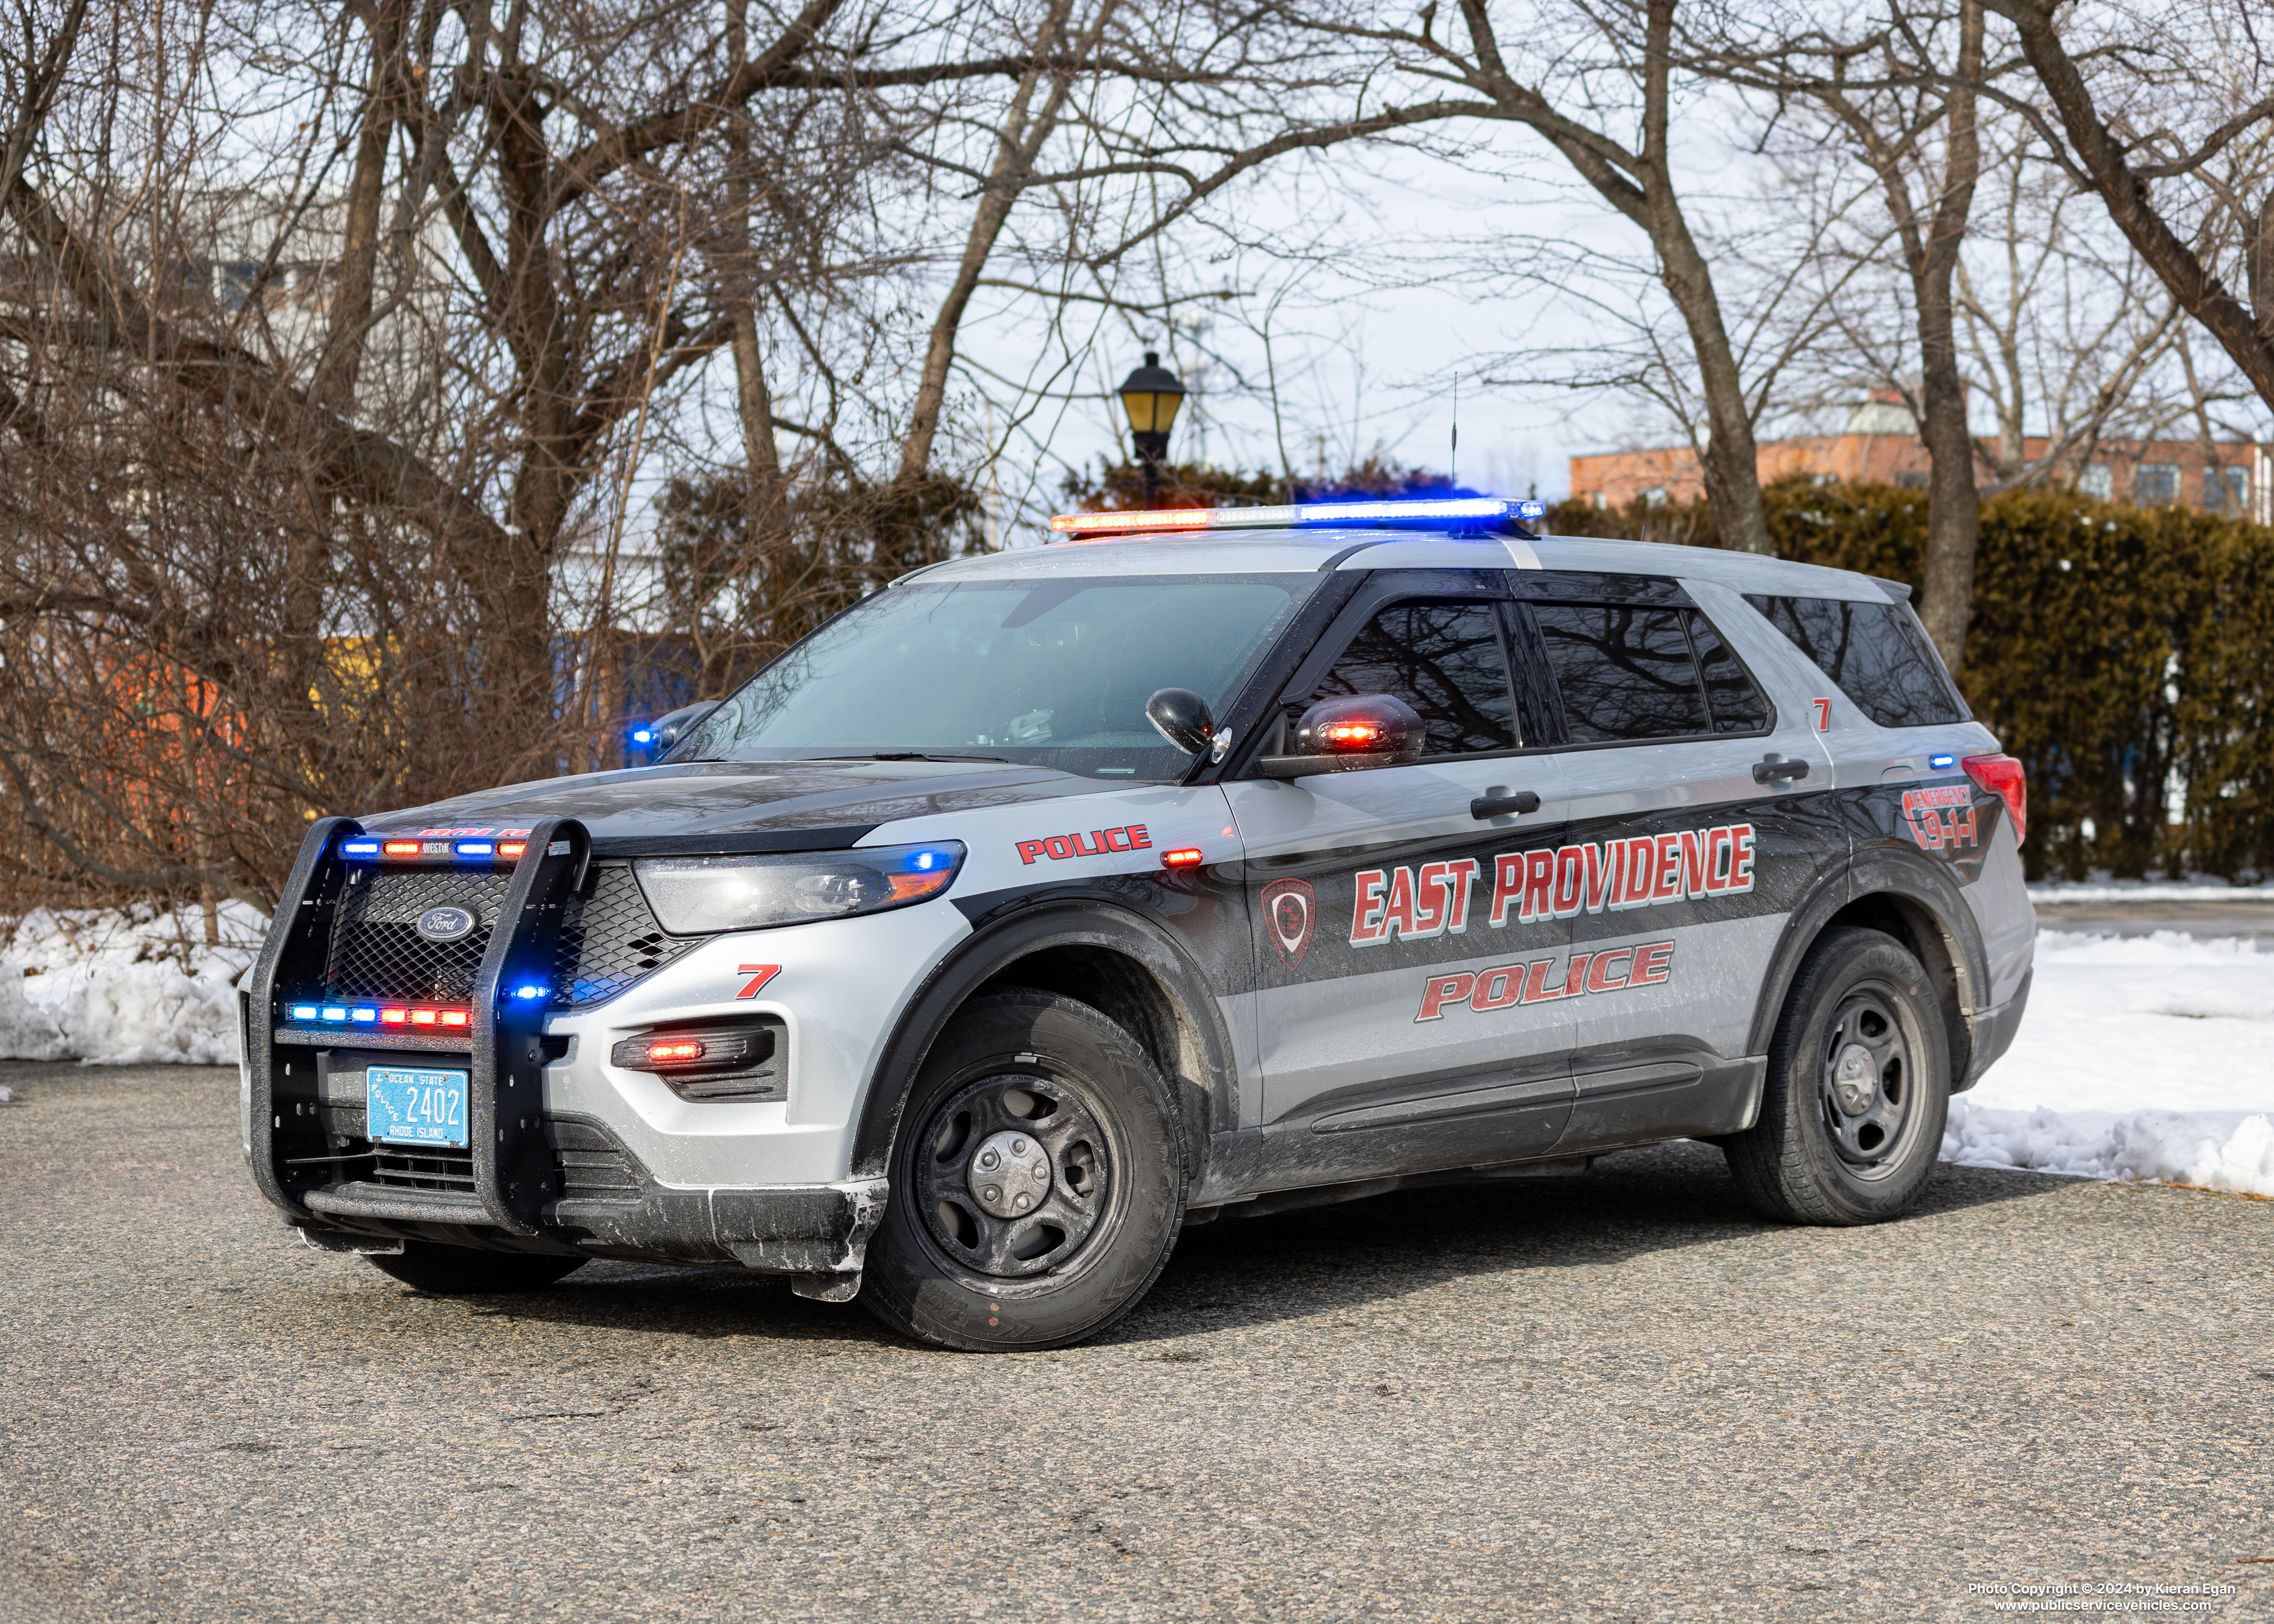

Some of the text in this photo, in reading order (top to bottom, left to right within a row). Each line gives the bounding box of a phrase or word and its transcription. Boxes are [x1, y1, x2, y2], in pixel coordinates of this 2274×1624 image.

[1813, 697, 1832, 732] 7
[1915, 786, 1972, 809] EMERGENCY
[1015, 824, 1152, 865] POLICE
[1922, 807, 1978, 850] 9-1-1
[1349, 824, 1756, 948] EAST PROVIDENCE
[428, 912, 459, 930] Ford
[735, 964, 782, 1000] 7
[1414, 940, 1674, 1024] POLICE
[390, 1074, 444, 1086] OCEAN STATE
[372, 1084, 399, 1122] POLICE
[407, 1087, 459, 1125] 2402
[390, 1125, 443, 1140] RHODE ISLAND
